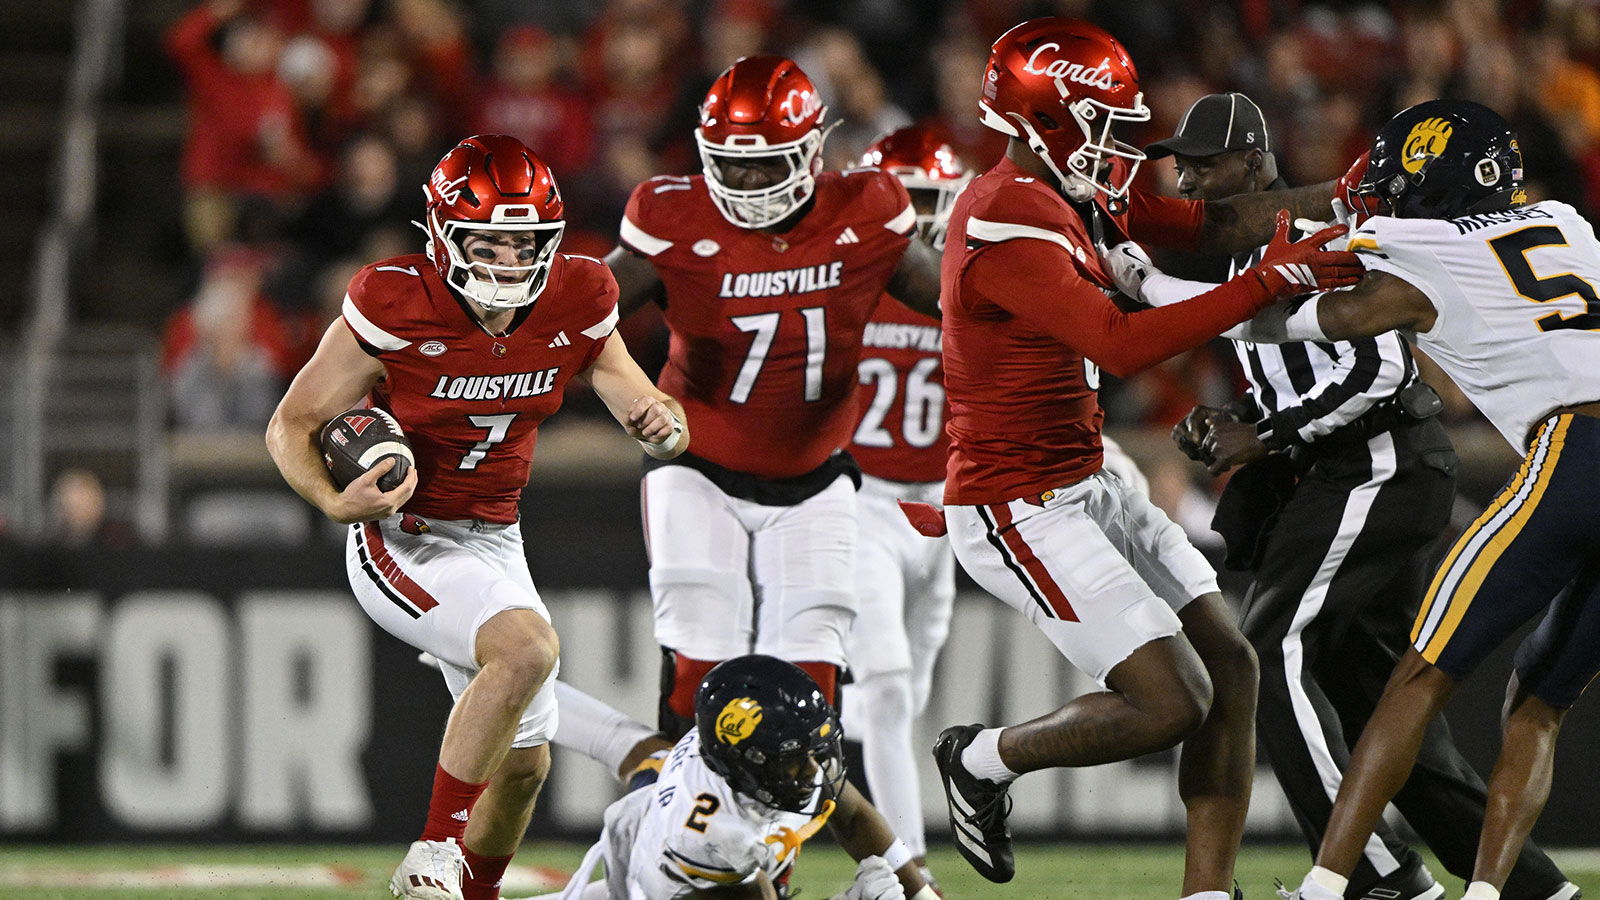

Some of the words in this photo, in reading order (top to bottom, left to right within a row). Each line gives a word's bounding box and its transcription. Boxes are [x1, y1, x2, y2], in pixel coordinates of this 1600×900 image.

[1023, 42, 1113, 91] Cards
[1246, 131, 1255, 144] S
[1405, 135, 1436, 159] Cal
[718, 260, 844, 298] LOUISVILLE
[1485, 224, 1600, 333] 5
[728, 306, 827, 404] 71
[429, 366, 560, 401] LOUISVILLE
[852, 357, 945, 449] 26
[456, 412, 519, 471] 7
[0, 592, 376, 832] FOR
[719, 711, 746, 737] Cal
[684, 791, 721, 834] 2
